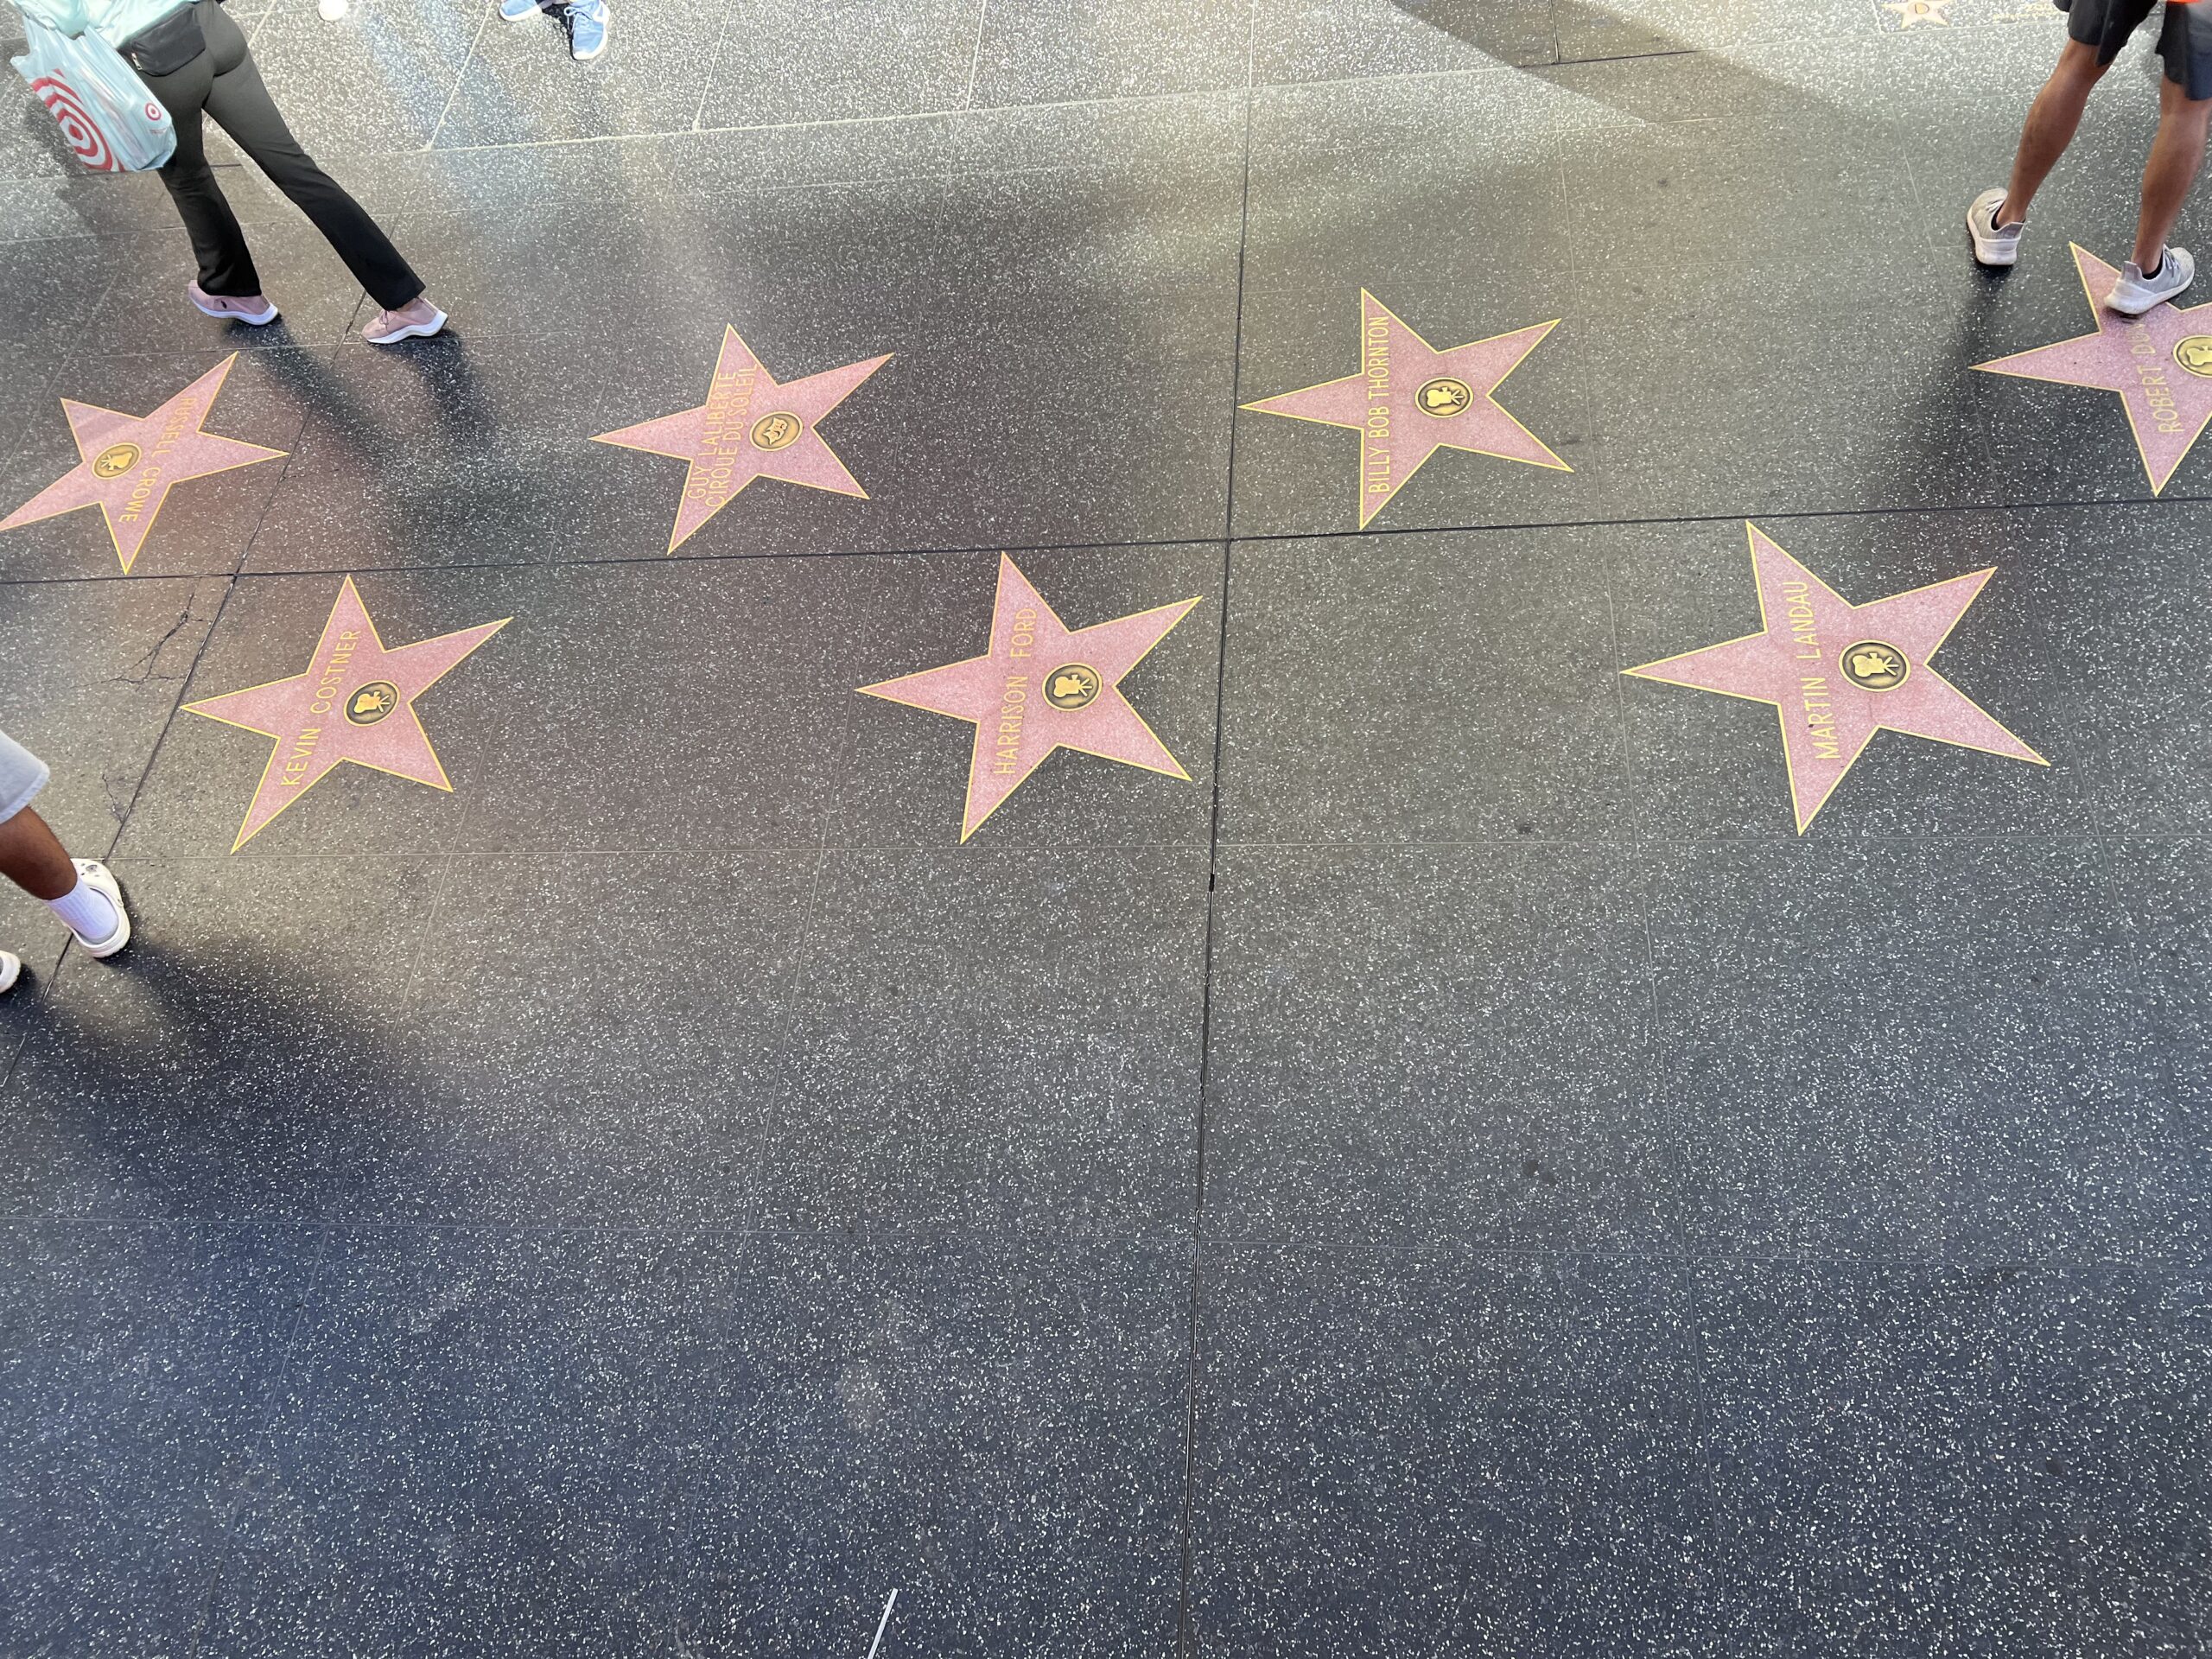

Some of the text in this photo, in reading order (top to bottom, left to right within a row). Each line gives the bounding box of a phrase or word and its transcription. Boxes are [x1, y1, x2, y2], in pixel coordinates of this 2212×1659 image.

[118, 397, 197, 523] RUSSELL CROWE
[688, 372, 736, 499] GUY LALIBERTE
[705, 363, 758, 507] CIRQUE DU SOLEIL
[1368, 316, 1390, 493] BILLY BOB THORNTON
[2137, 365, 2185, 432] ROBERT
[281, 631, 361, 786] KEVIN COSTNER
[994, 608, 1037, 774] HARRISON FORD
[1783, 582, 1840, 759] MARTIN LANDAU
